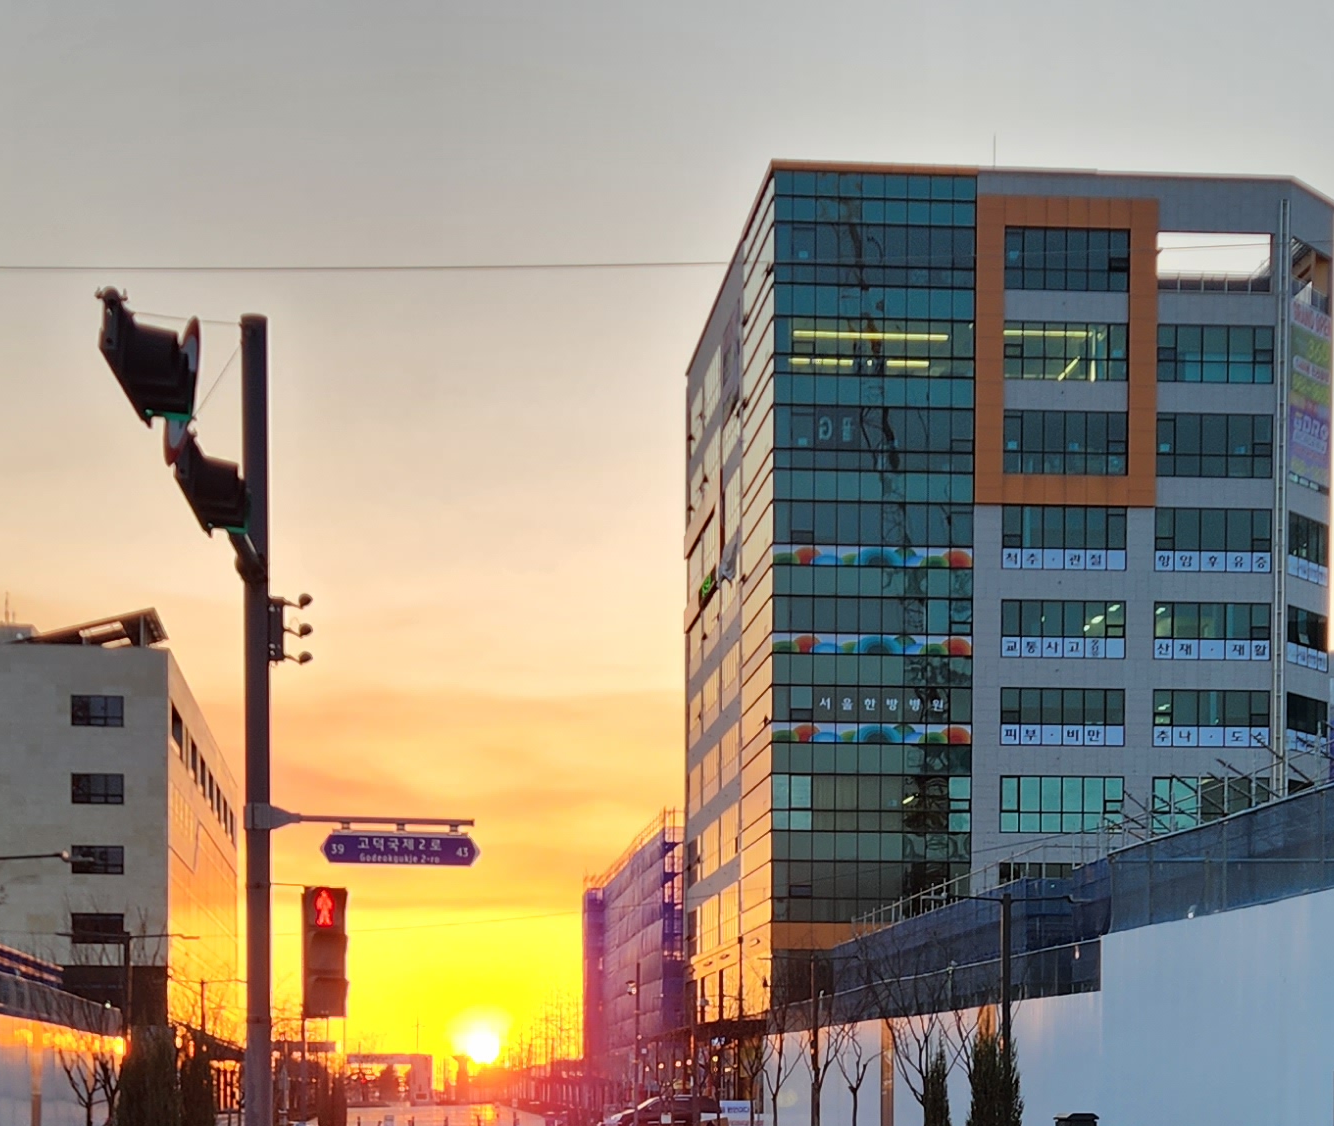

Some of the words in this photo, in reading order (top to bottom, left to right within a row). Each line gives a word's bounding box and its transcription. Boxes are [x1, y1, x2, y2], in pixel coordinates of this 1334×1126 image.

[819, 697, 944, 712] 서울한방병원
[330, 843, 345, 855] 39
[358, 837, 442, 852] 고덕국제2로
